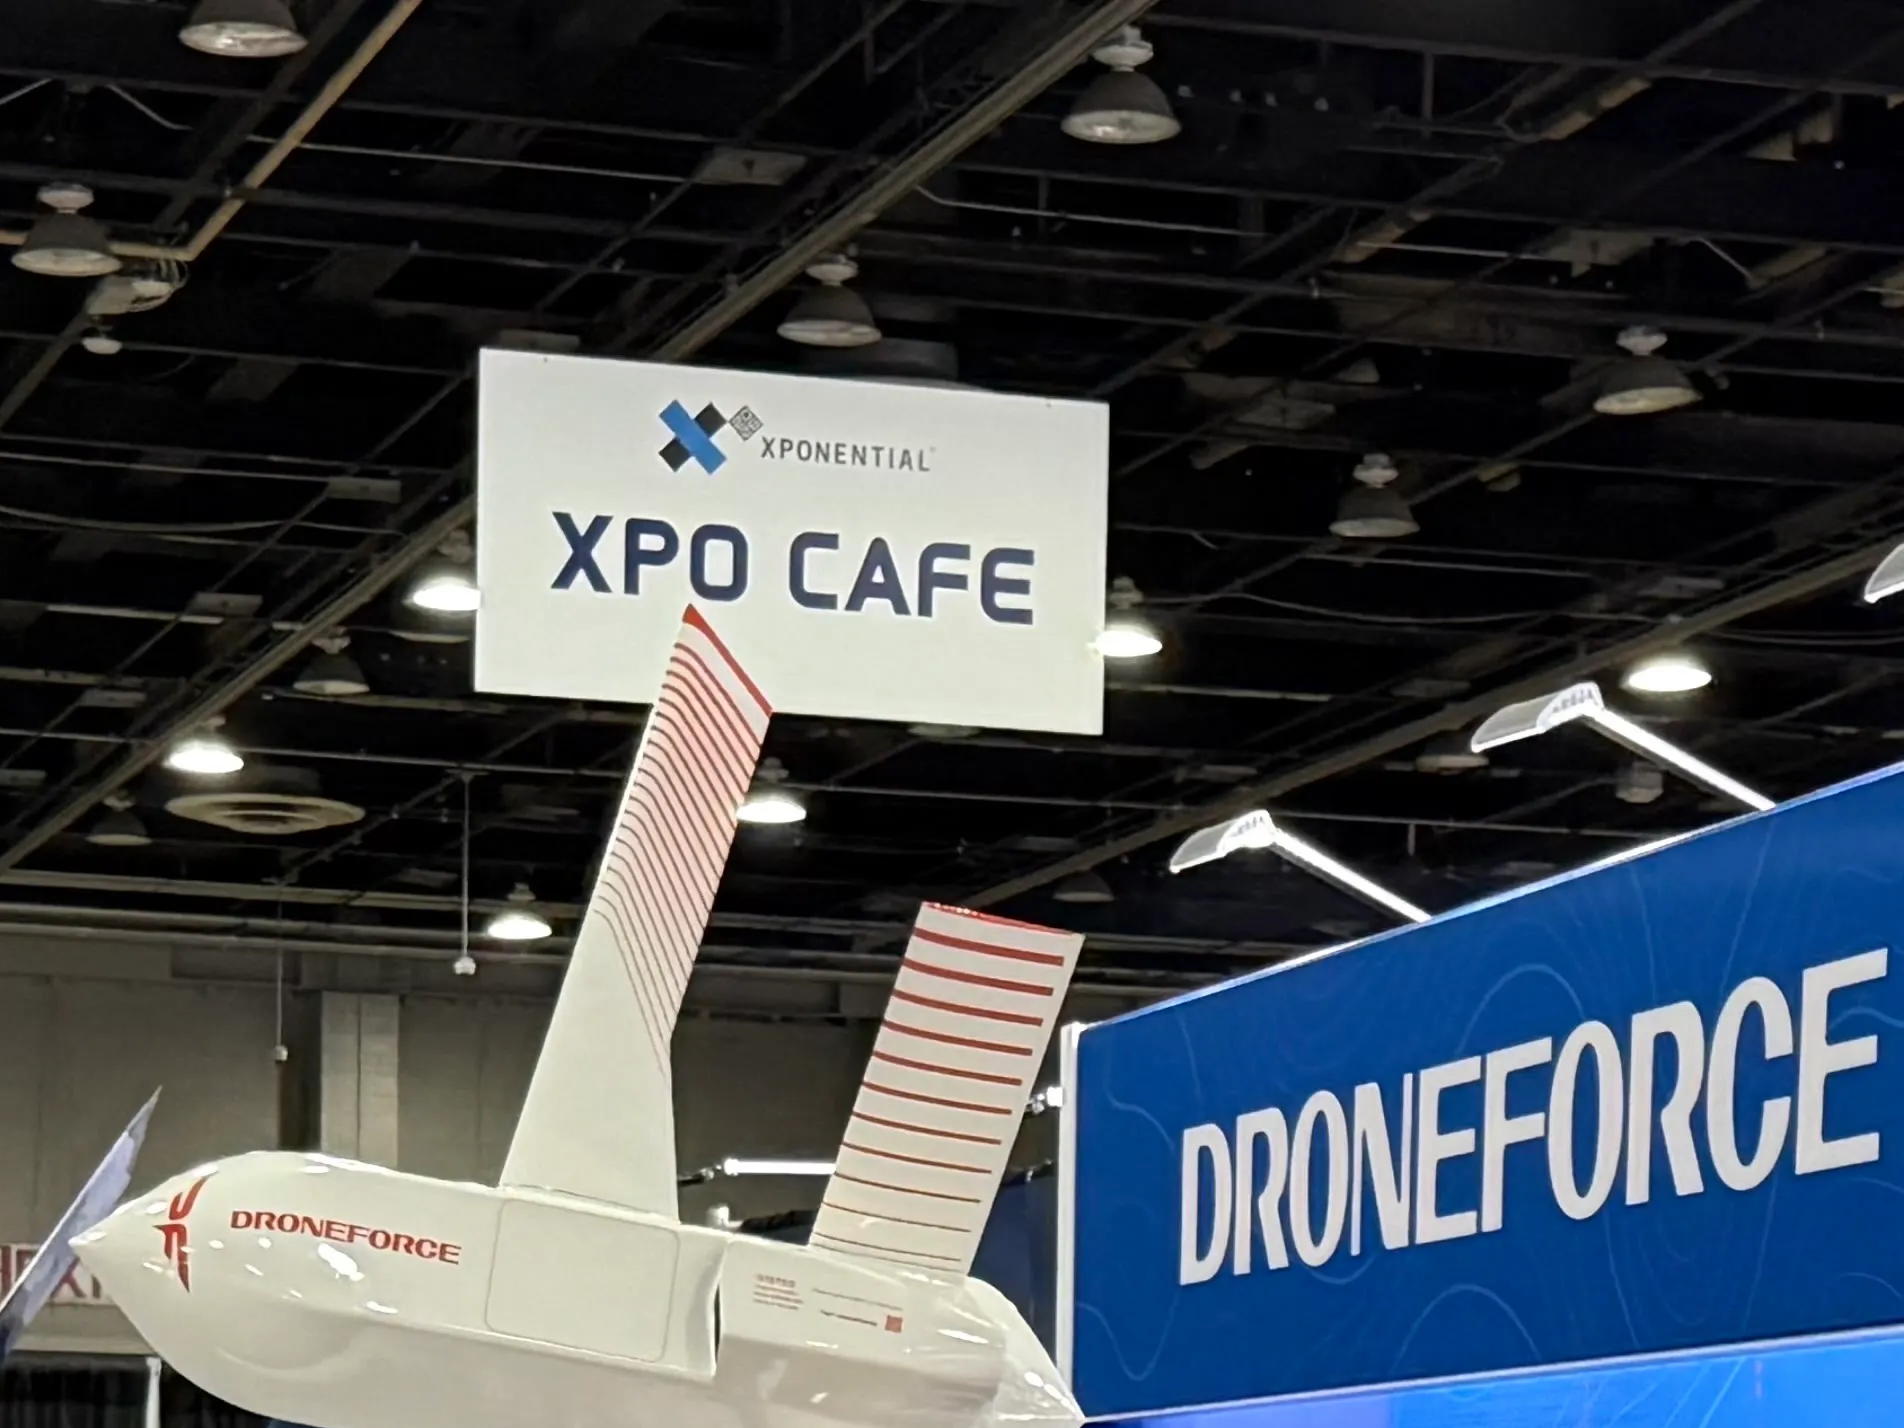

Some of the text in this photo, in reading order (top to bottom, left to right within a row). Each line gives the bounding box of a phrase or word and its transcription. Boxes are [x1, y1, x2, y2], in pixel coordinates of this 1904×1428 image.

[760, 436, 931, 473] XPONENTIAL
[550, 511, 1035, 625] XPO CAFE
[1178, 946, 1891, 1287] DRONEFORCE
[230, 1210, 462, 1265] DRONEFORCE
